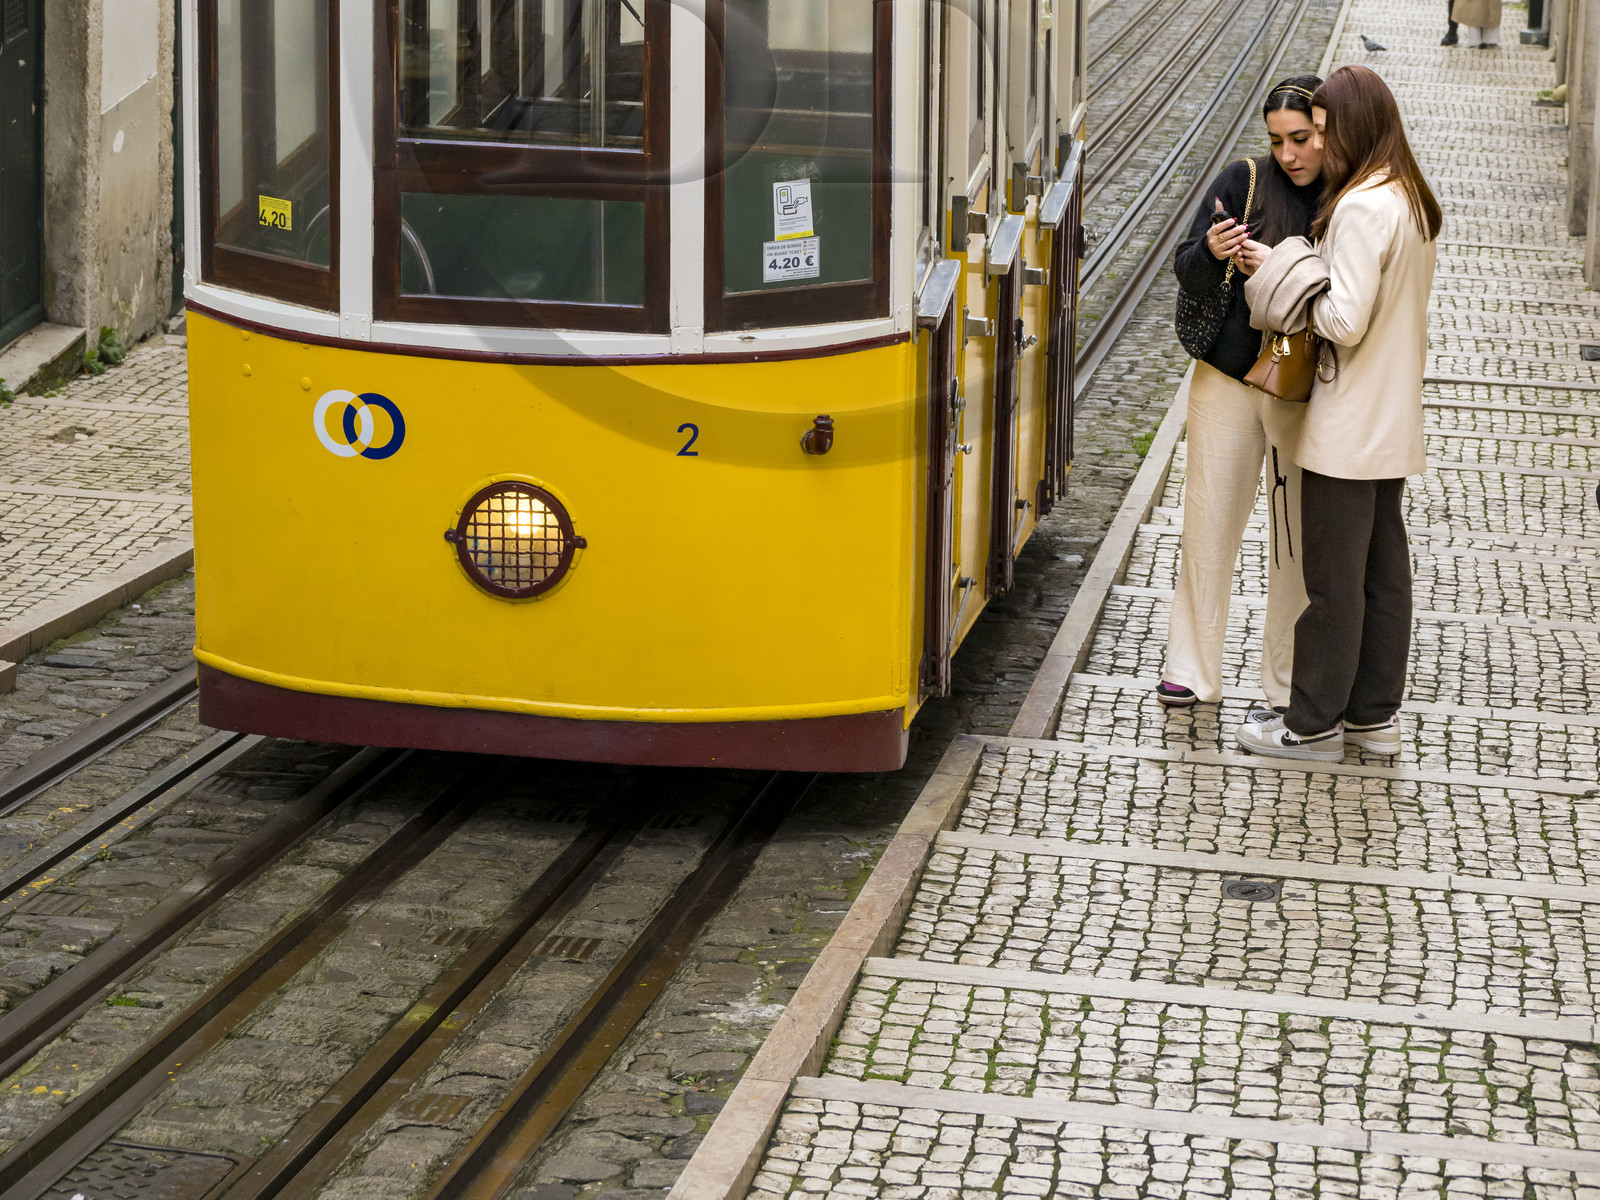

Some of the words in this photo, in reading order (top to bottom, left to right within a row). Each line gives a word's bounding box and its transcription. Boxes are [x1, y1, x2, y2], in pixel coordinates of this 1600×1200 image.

[769, 257, 800, 270] 4.20
[805, 255, 814, 267] €
[676, 423, 699, 457] 2
